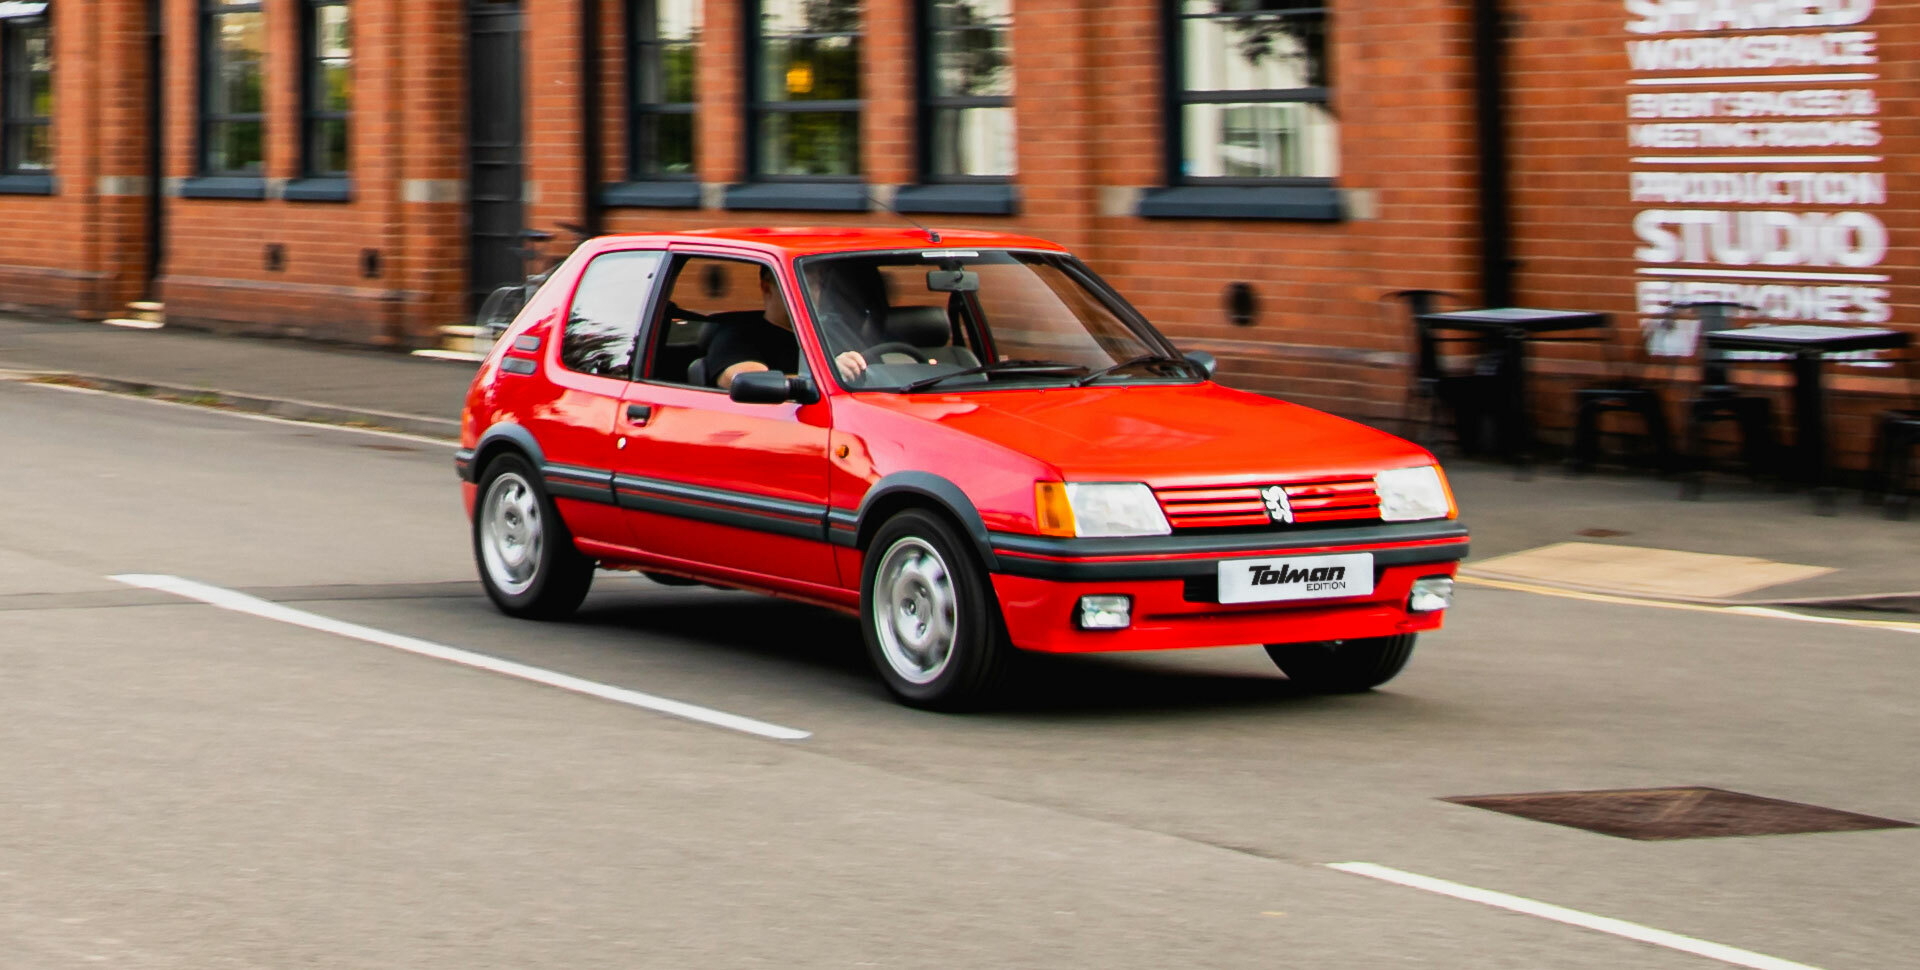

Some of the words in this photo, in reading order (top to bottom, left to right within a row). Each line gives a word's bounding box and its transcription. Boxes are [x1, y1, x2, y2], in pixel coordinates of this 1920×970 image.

[1630, 171, 1886, 204] PRODUCTION
[1633, 209, 1888, 267] STUDIO
[1249, 564, 1346, 586] Tolman
[1306, 581, 1346, 592] EDITION
